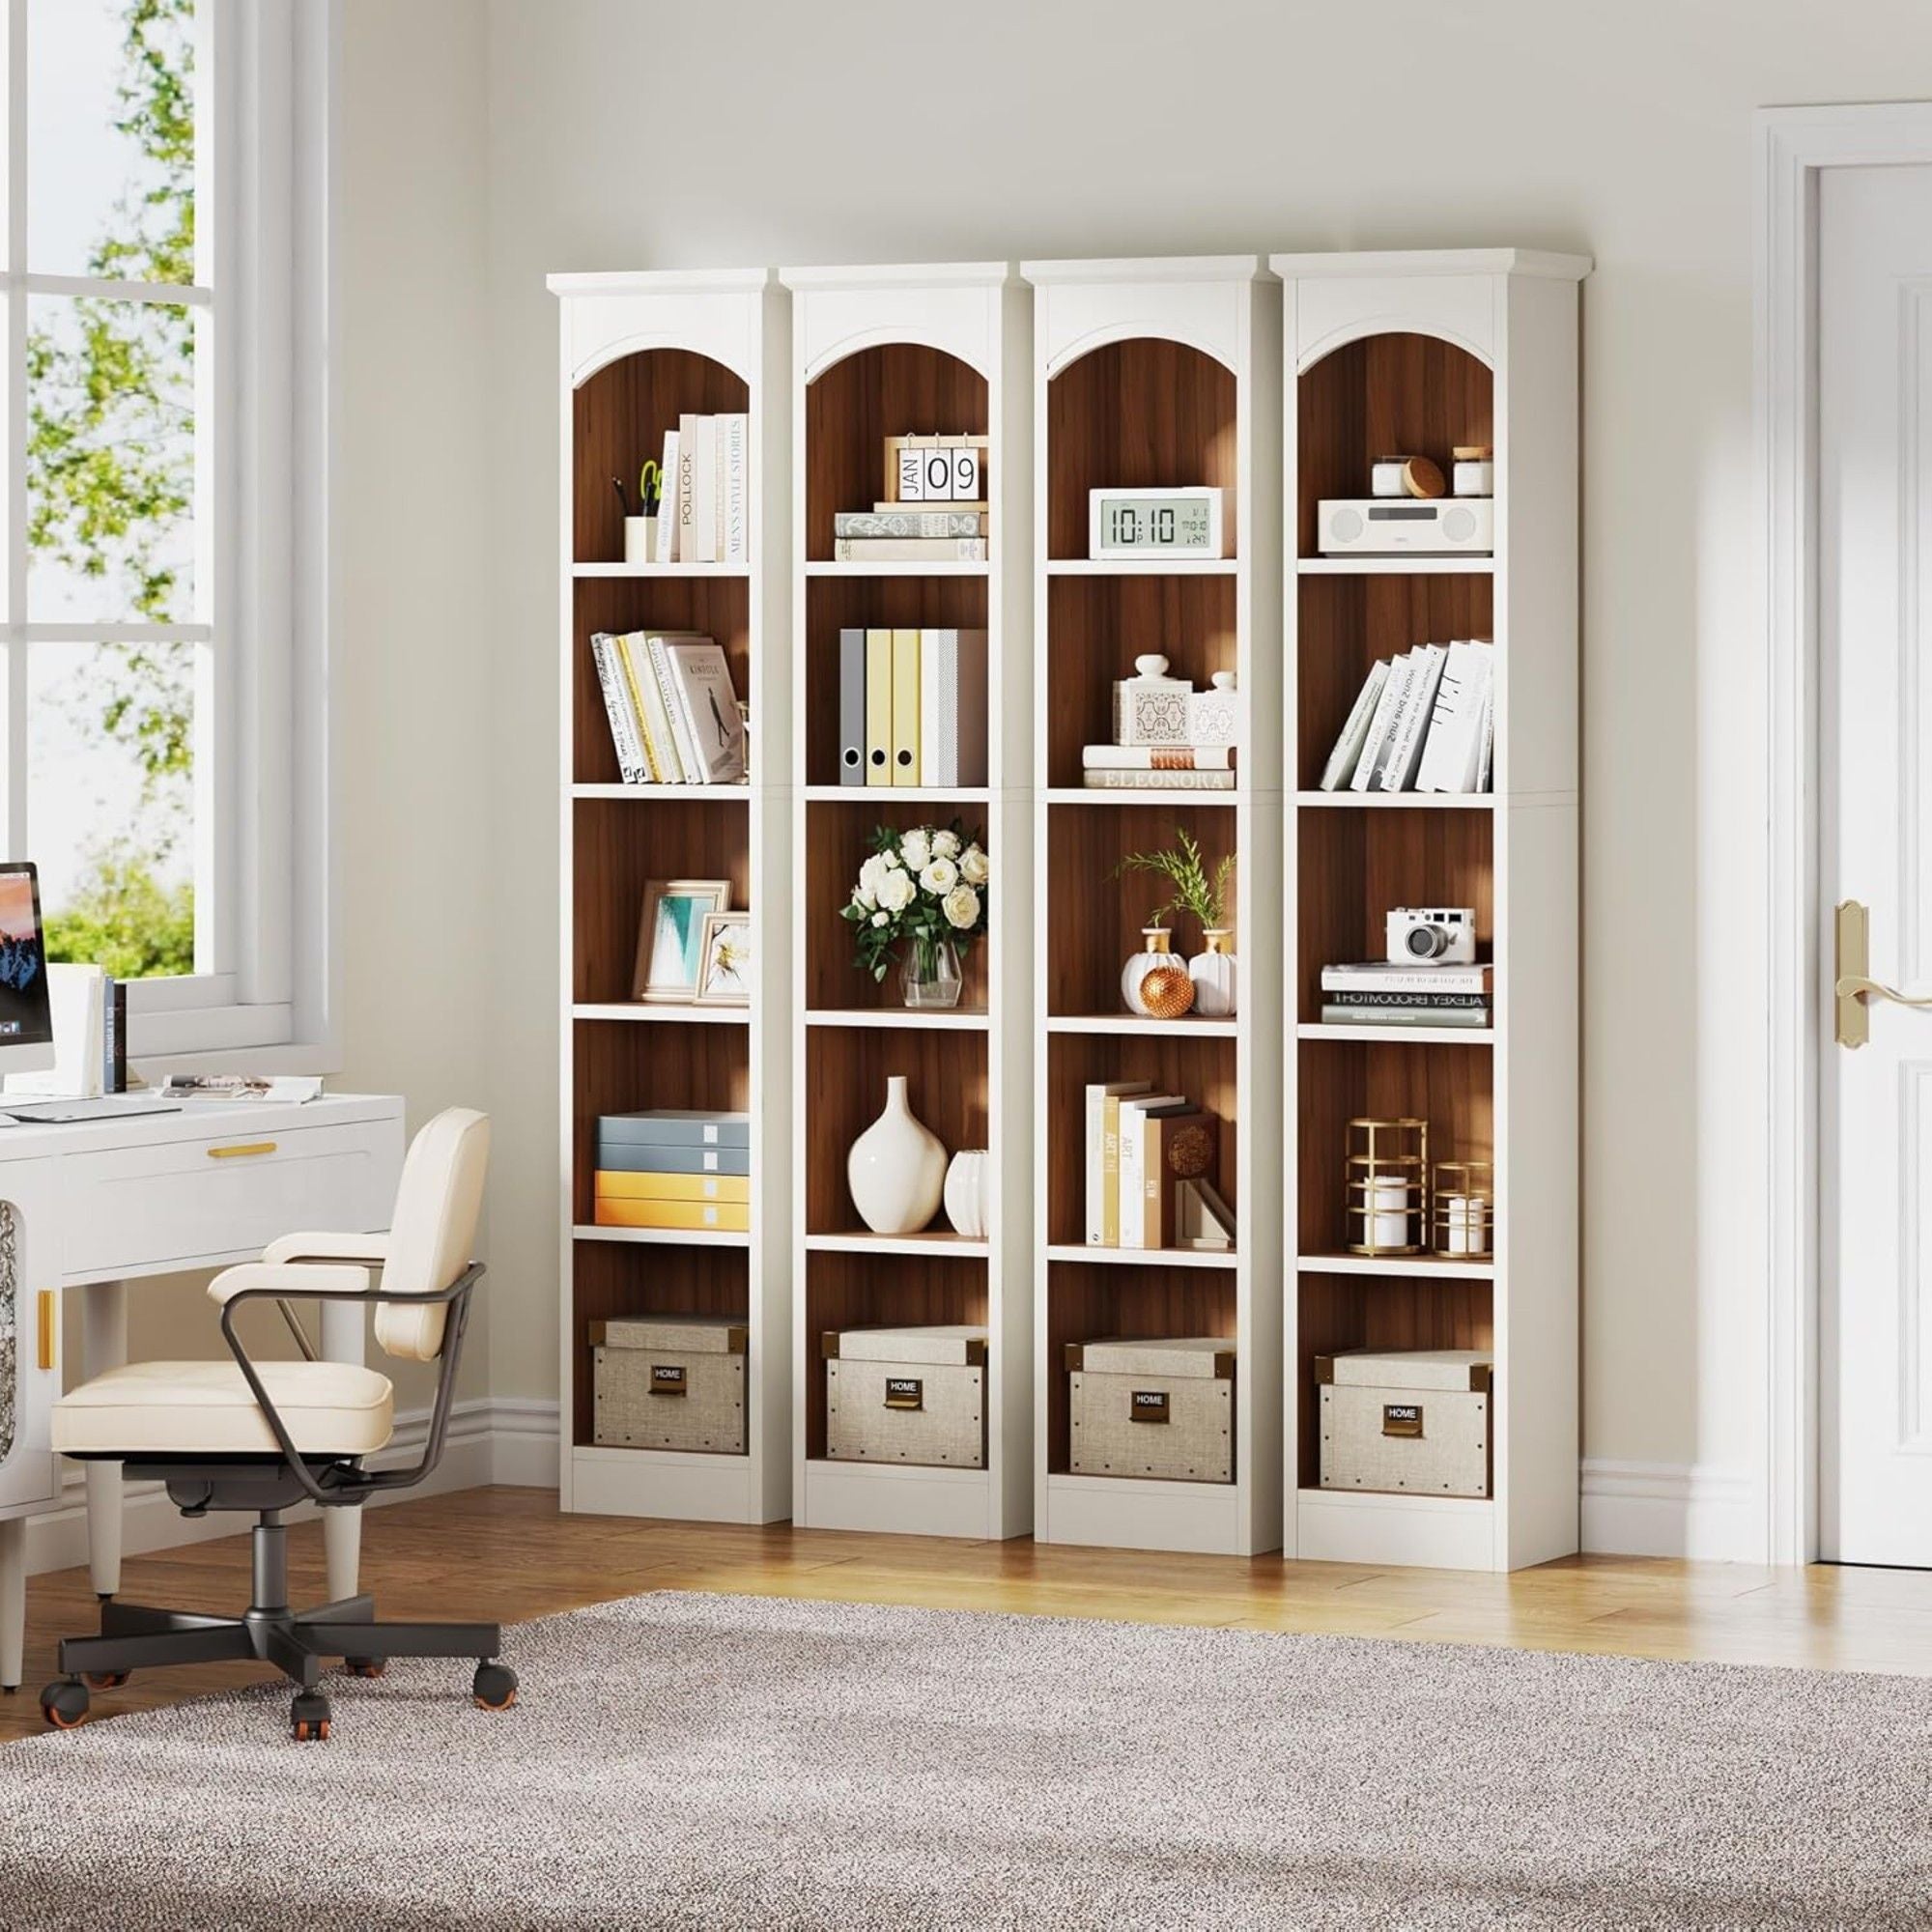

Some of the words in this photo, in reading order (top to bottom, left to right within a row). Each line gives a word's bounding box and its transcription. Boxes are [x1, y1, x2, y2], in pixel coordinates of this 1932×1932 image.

[903, 459, 919, 494] JAN
[682, 454, 692, 525] POLLOCK
[1113, 509, 1175, 543] 10:10
[1104, 772, 1225, 789] ELEONORA
[656, 1369, 681, 1379] HOME
[891, 1381, 917, 1392] HOME
[1136, 1394, 1163, 1406] HOME
[1388, 1407, 1416, 1419] HOME
